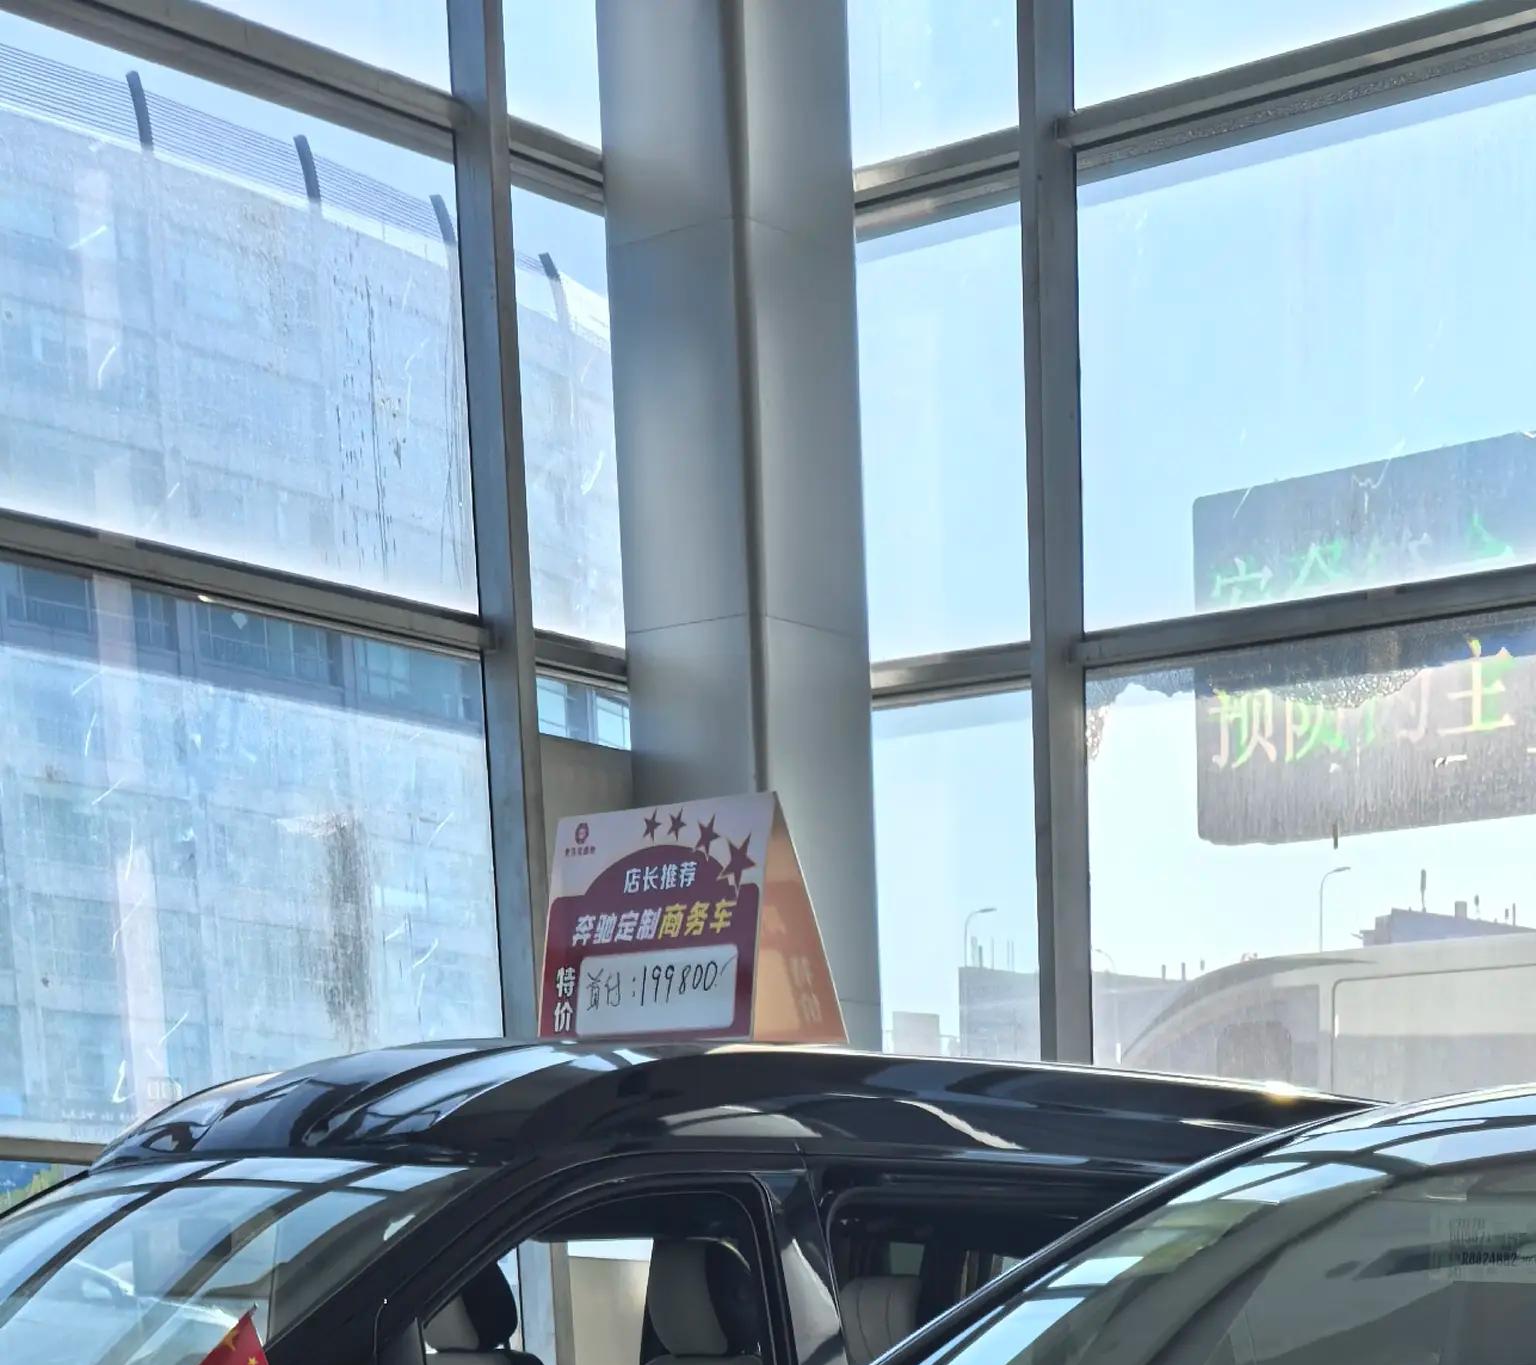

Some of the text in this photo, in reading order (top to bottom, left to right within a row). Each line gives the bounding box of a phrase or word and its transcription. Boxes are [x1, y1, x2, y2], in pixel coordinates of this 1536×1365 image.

[624, 861, 698, 894] 店长推荐
[572, 898, 738, 947] 奔驰定制商务车
[554, 966, 576, 1032] 特价
